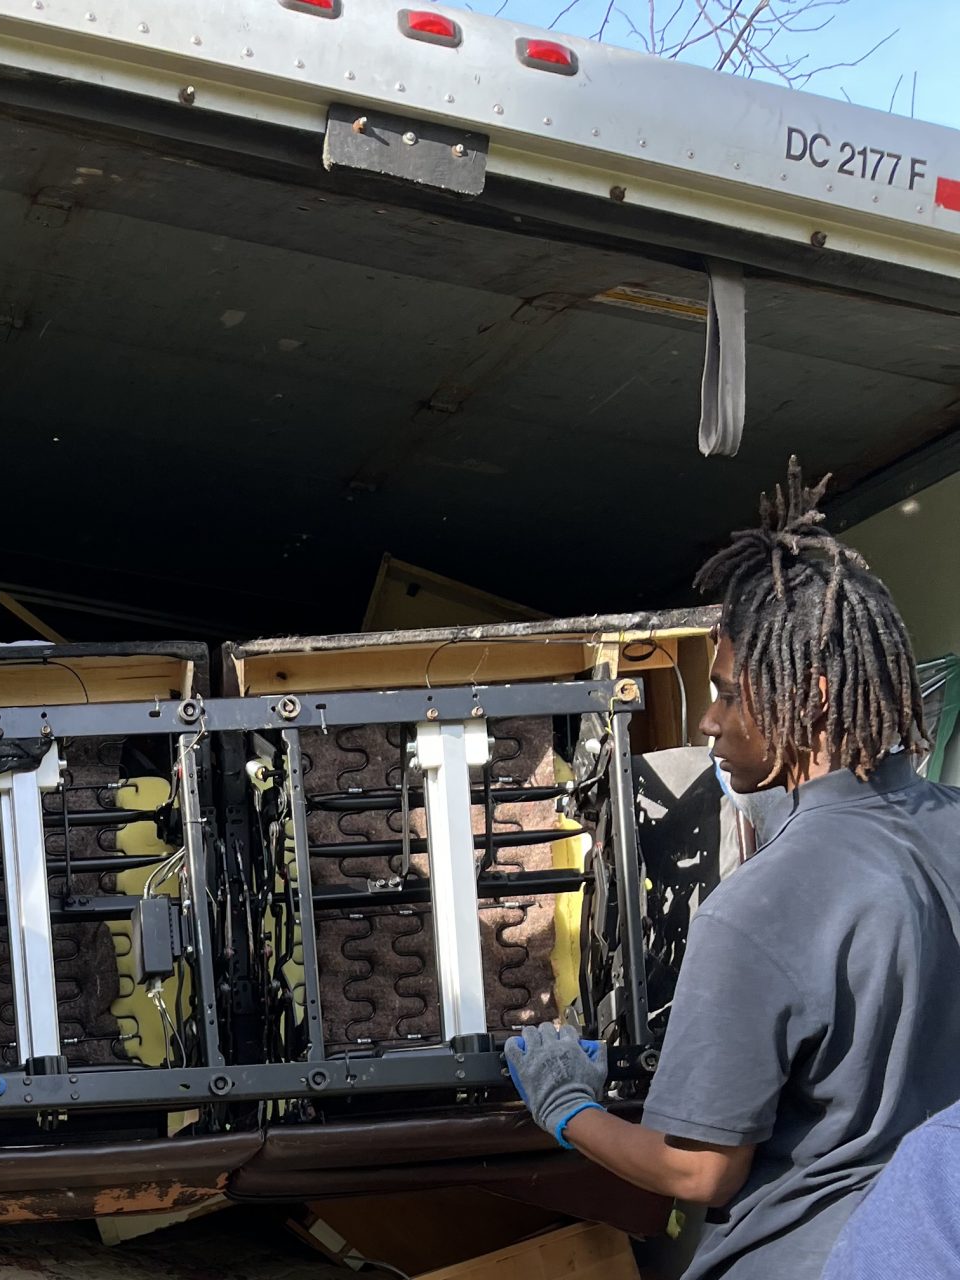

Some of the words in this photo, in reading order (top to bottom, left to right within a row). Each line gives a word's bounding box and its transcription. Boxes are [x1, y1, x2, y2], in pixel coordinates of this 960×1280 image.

[785, 126, 831, 168] DC
[837, 141, 902, 185] 2177
[908, 157, 927, 190] F
